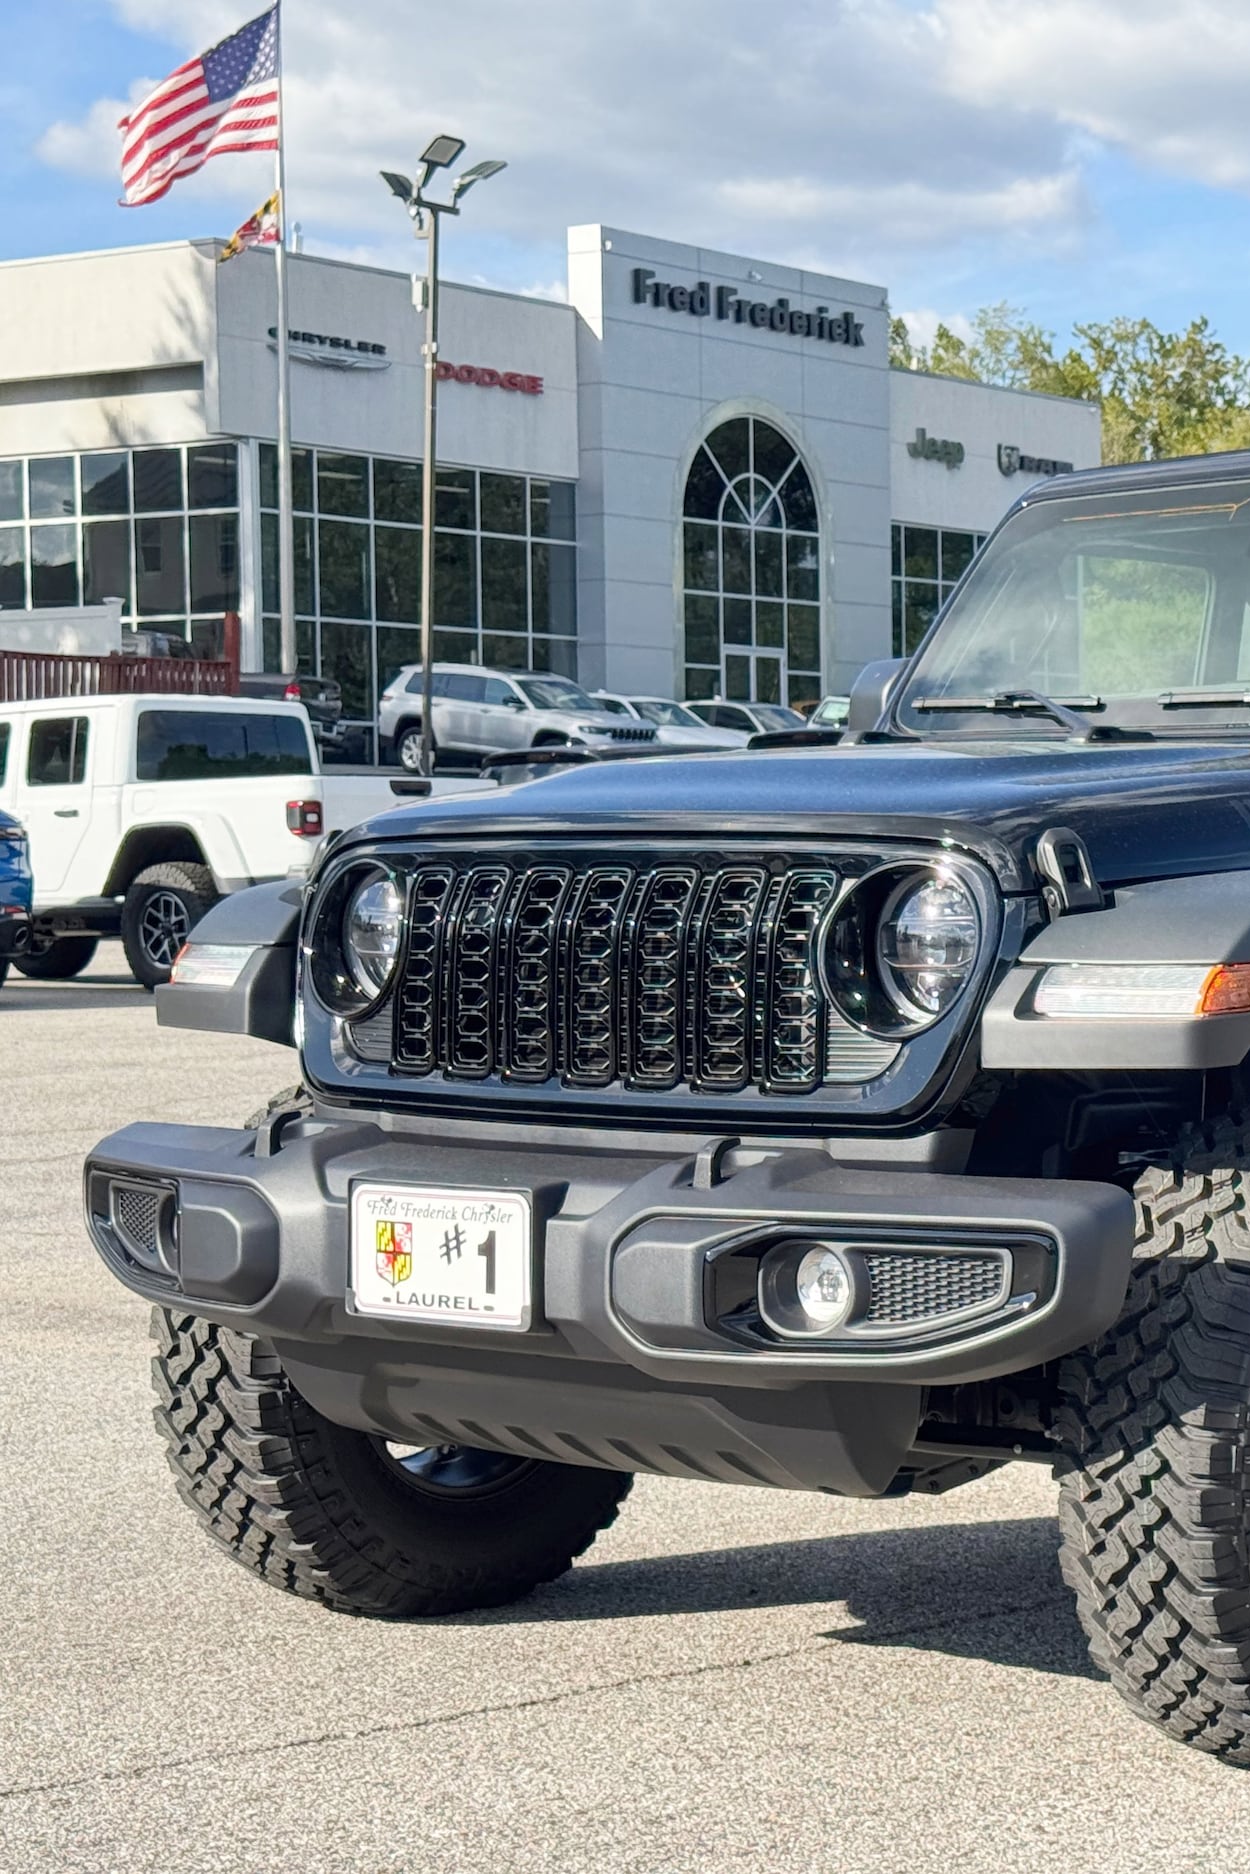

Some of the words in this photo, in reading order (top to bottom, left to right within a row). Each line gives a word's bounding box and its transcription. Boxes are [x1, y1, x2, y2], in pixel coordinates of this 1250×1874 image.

[632, 267, 710, 317] Fred
[716, 285, 865, 347] Frederick
[435, 360, 544, 395] DODGE
[367, 1199, 397, 1217] Fred
[400, 1202, 457, 1221] Frederick
[462, 1205, 514, 1225] Chrysler
[396, 1291, 480, 1311] LAUREL
